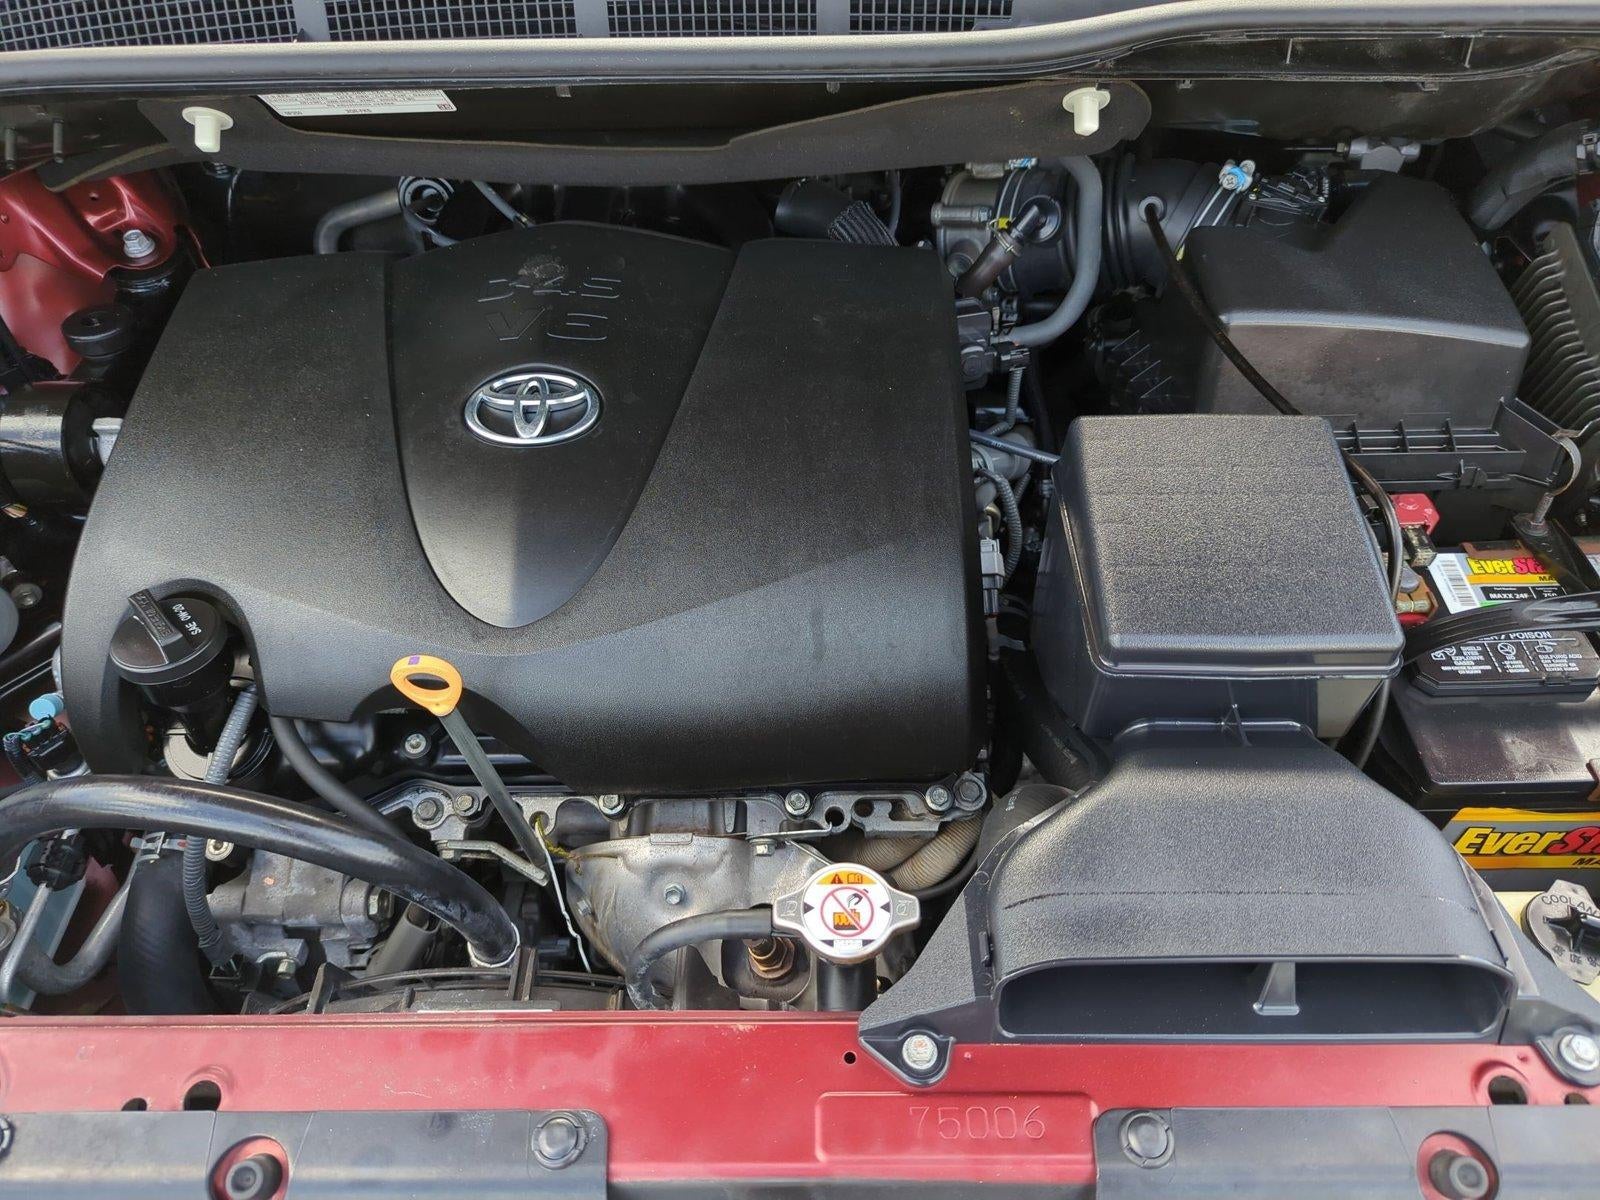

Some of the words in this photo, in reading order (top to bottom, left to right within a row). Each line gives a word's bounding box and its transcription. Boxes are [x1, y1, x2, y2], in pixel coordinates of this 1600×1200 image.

[1489, 592, 1514, 600] MAXX
[172, 603, 191, 622] 0W-20
[185, 621, 202, 636] SAE
[1509, 631, 1553, 640] POISON
[1541, 894, 1600, 917] COOLAN
[909, 1105, 1046, 1140] 75006
